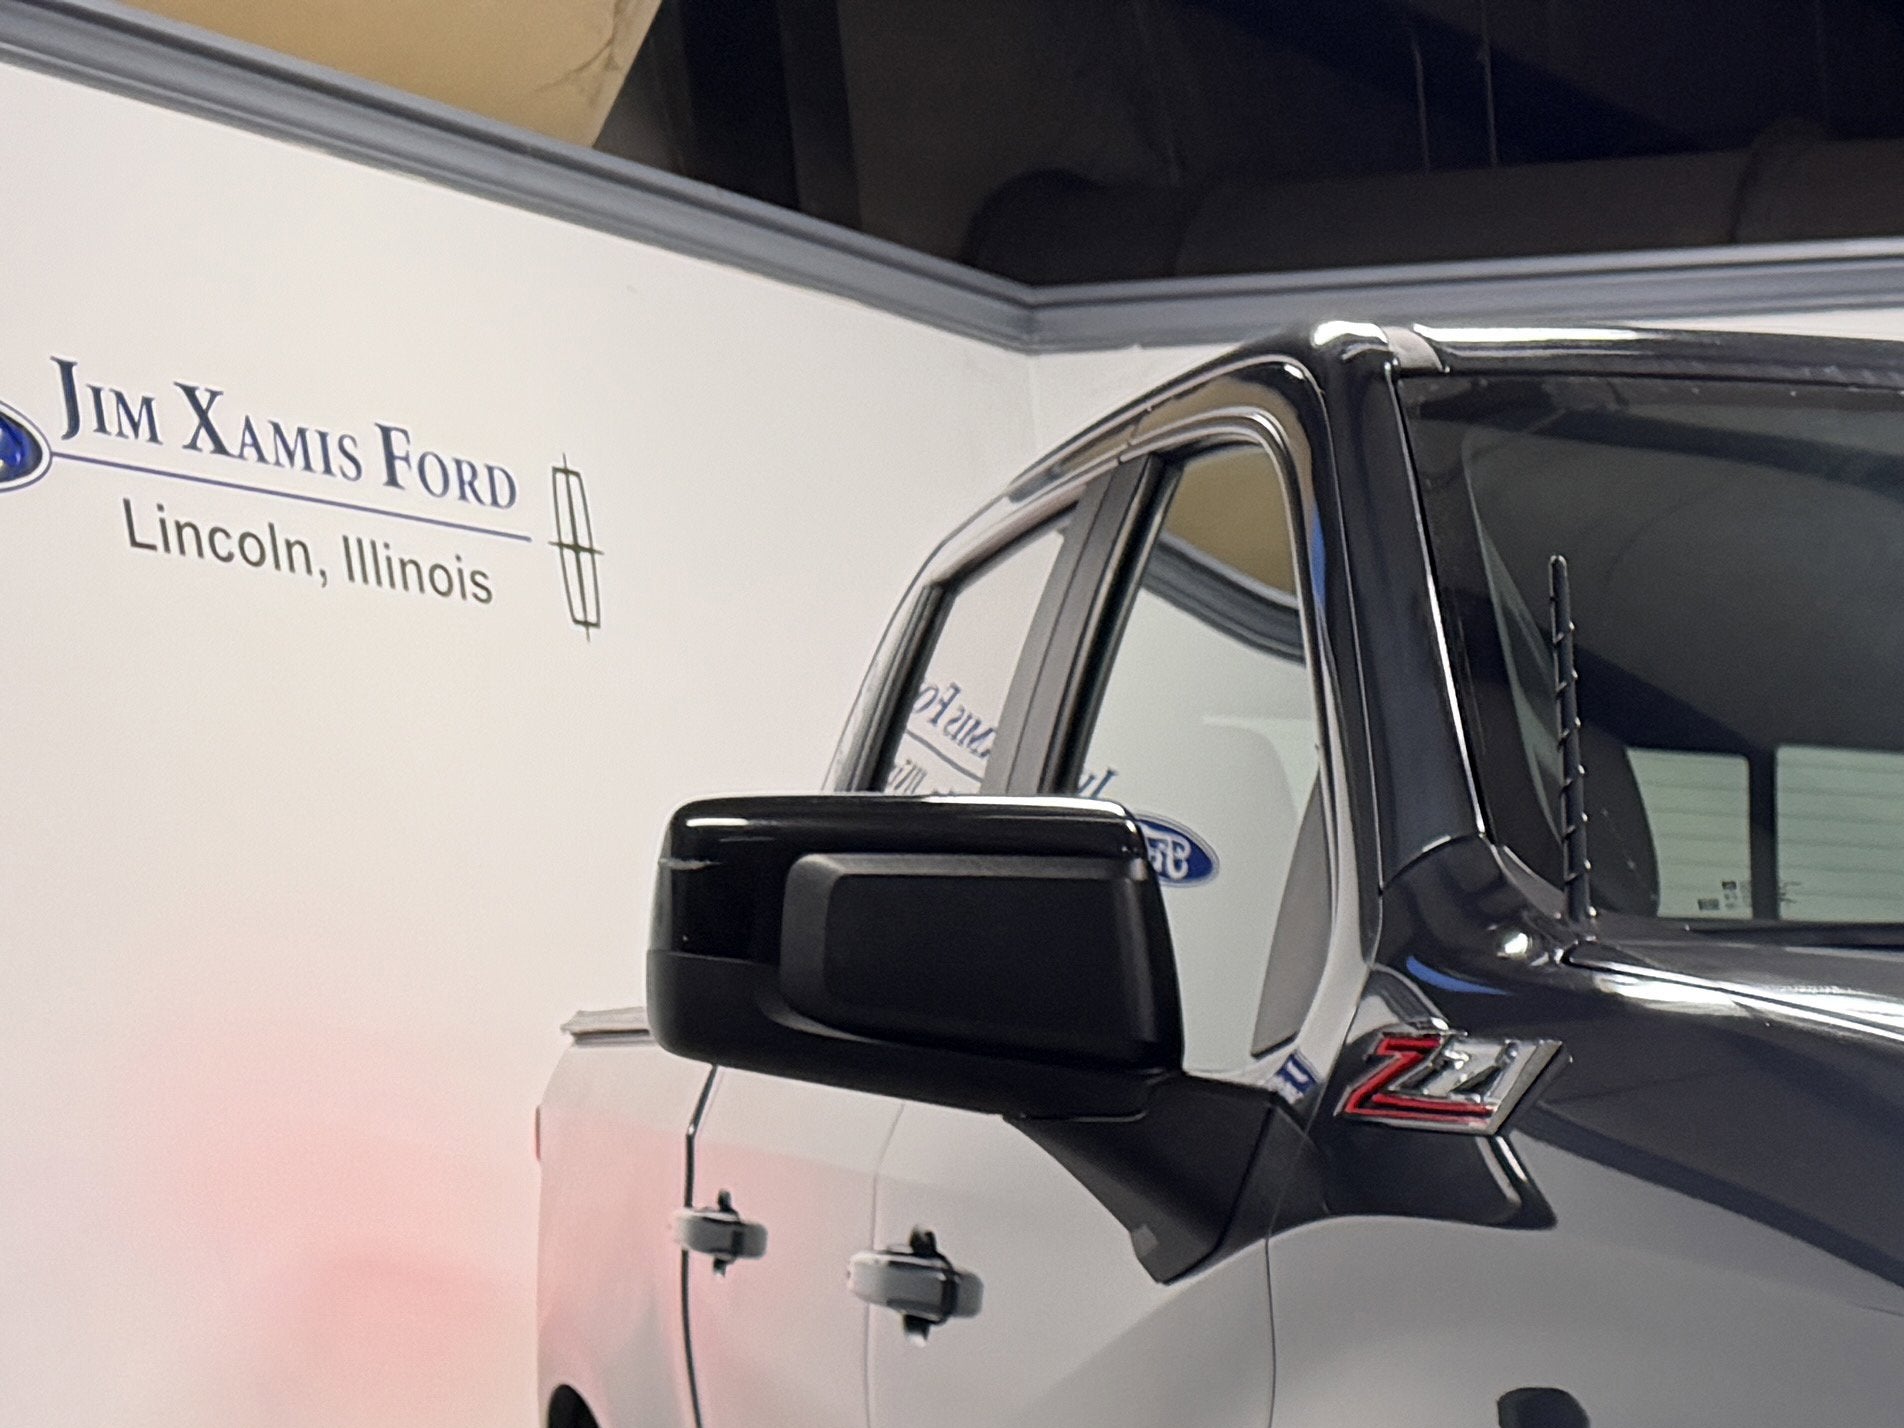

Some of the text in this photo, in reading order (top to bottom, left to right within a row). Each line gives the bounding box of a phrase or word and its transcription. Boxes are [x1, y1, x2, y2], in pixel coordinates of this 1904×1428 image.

[50, 355, 518, 510] JIM XAMIS FORD
[121, 497, 495, 605] Lincoln, Illinois
